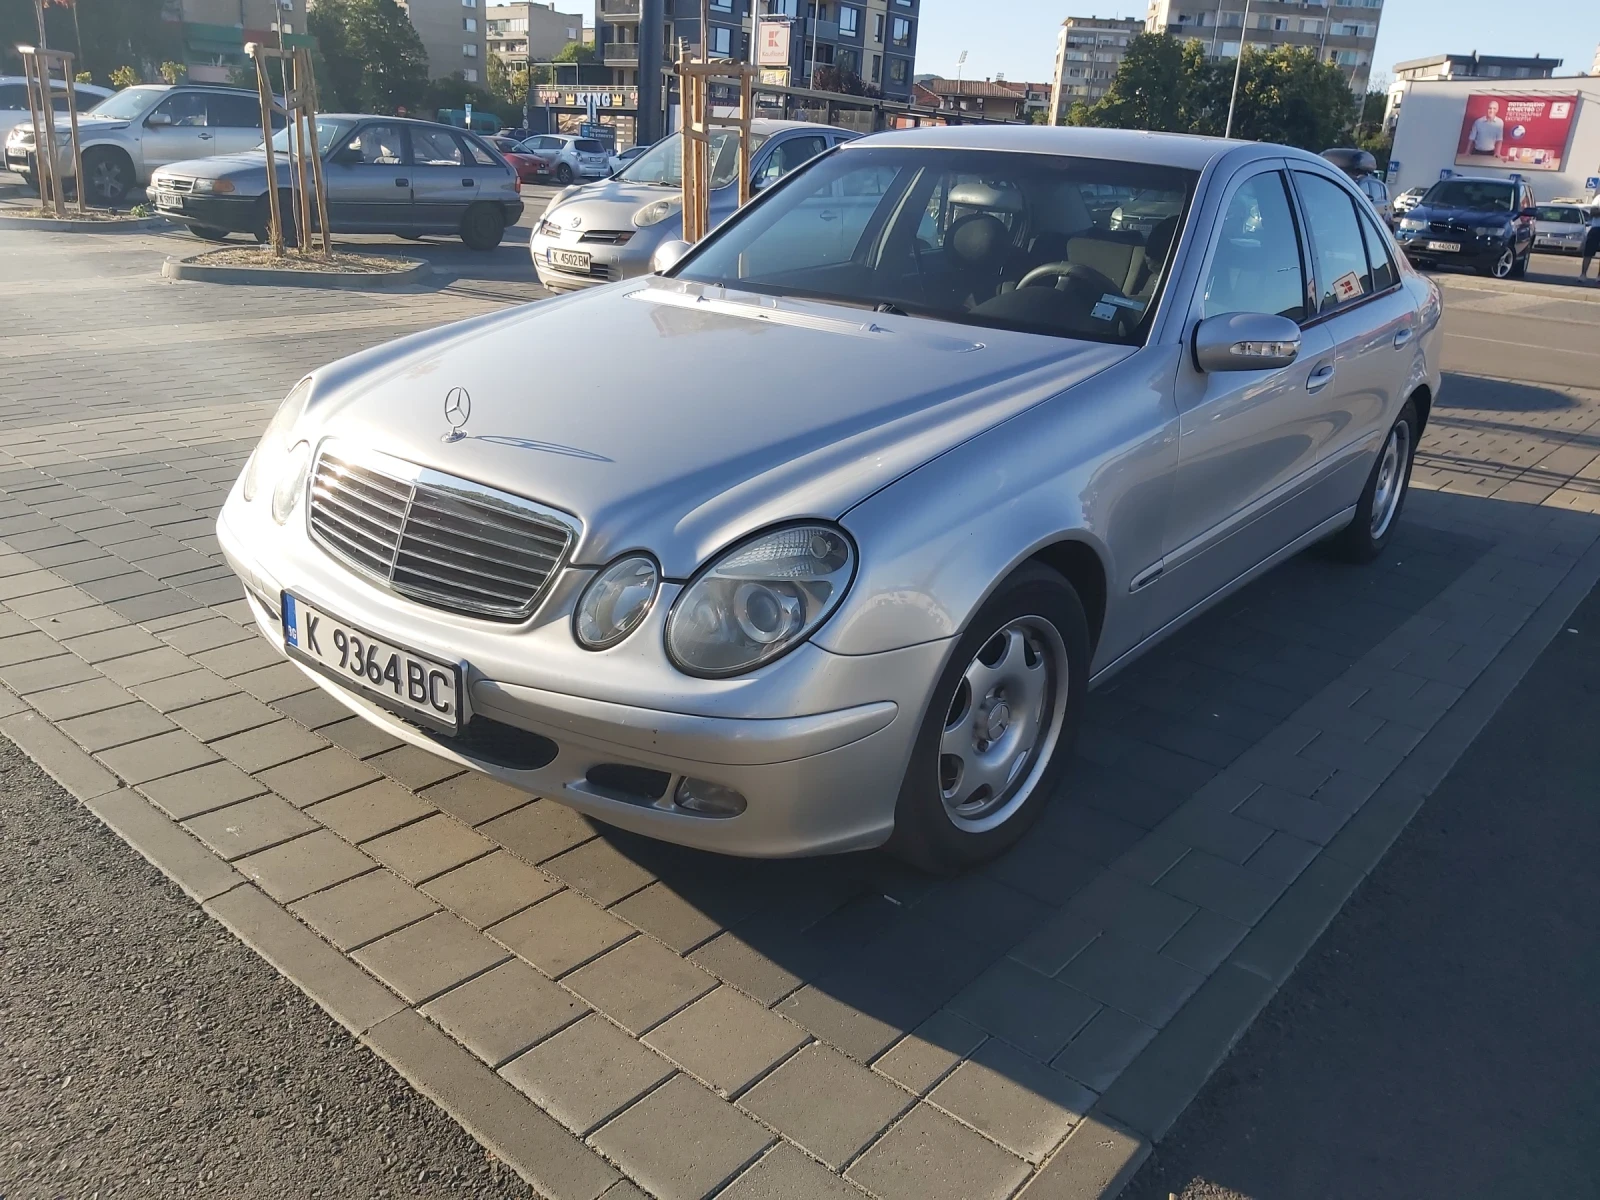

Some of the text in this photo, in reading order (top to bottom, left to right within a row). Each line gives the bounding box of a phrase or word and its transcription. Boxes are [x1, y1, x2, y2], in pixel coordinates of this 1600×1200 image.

[576, 92, 611, 107] KING
[553, 252, 589, 267] K 4502 BM
[305, 611, 450, 714] K 9364 BC
